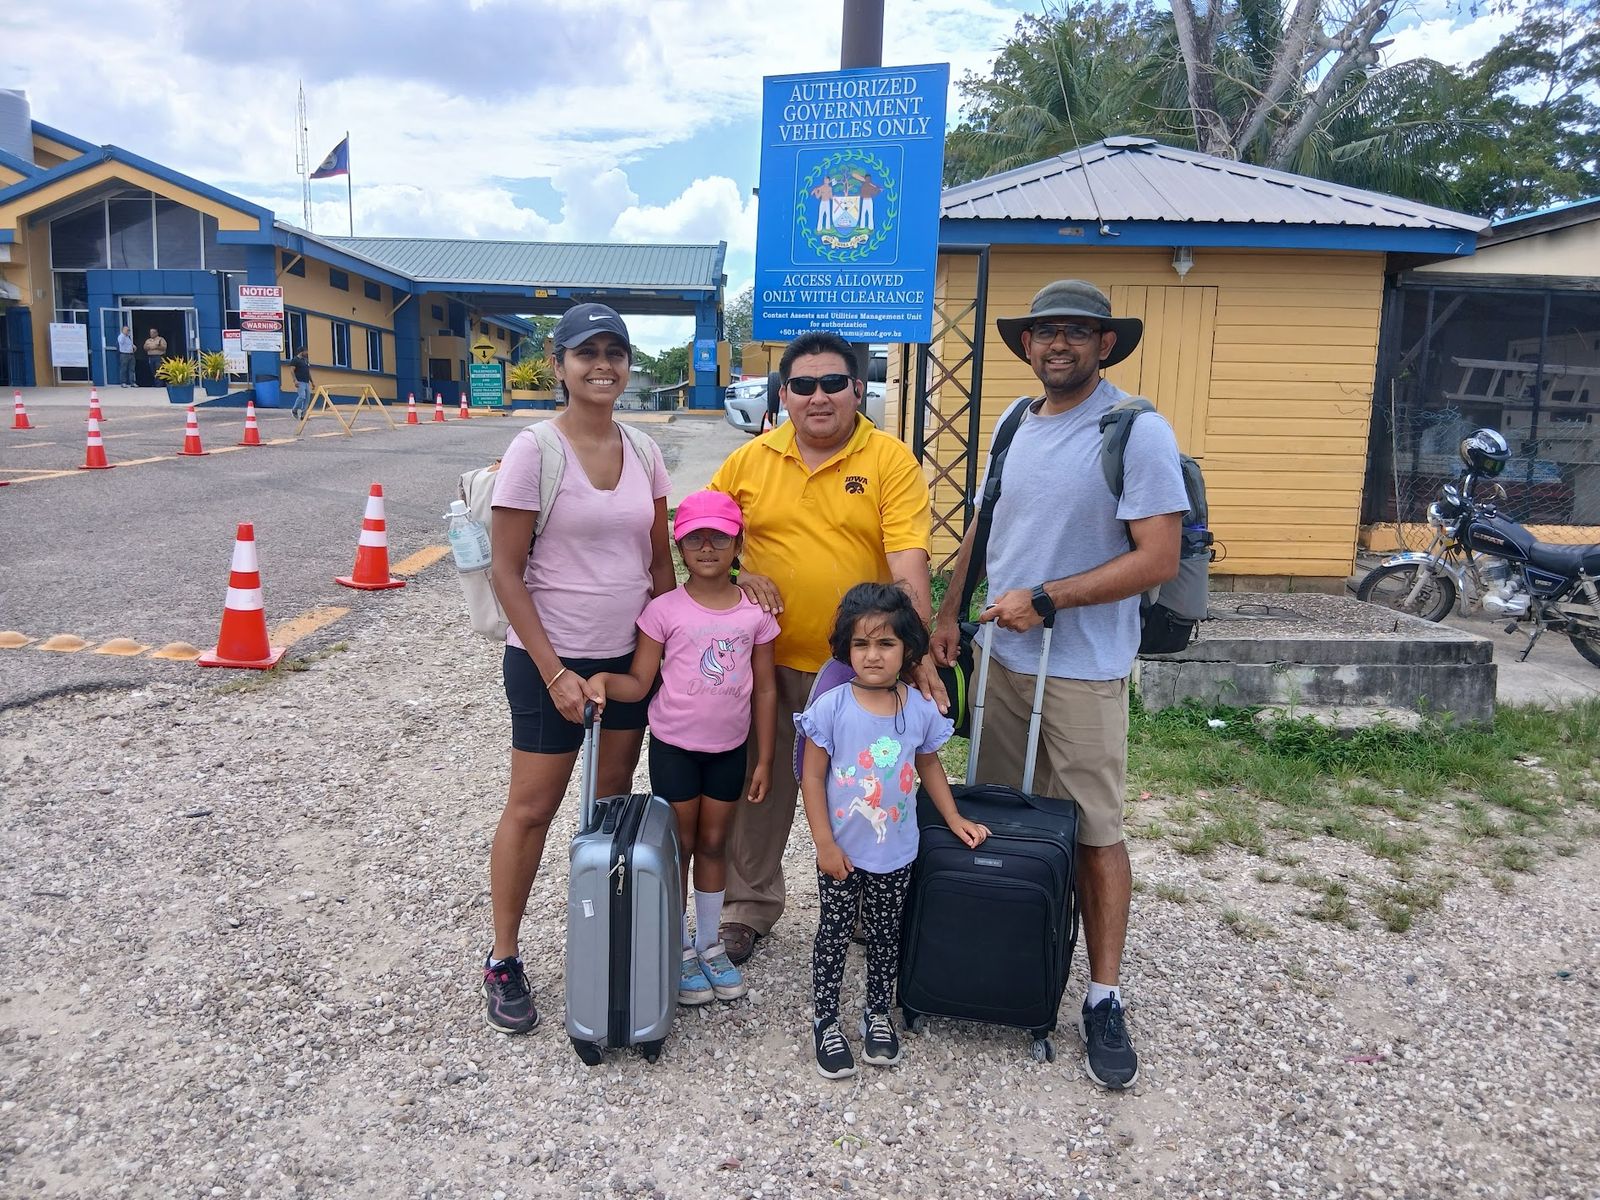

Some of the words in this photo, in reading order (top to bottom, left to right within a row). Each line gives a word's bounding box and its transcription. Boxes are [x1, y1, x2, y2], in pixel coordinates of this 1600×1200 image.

[789, 77, 917, 103] AUTHORIZED
[783, 97, 923, 122] GOVERNMENT
[779, 120, 872, 141] VEHICLES
[877, 116, 932, 137] ONLY
[782, 274, 831, 287] ACCESS
[835, 274, 903, 287] ALLOWED
[242, 287, 280, 297] NOTICE
[762, 290, 797, 303] ONLY
[800, 290, 837, 303] WITH
[840, 291, 924, 304] CLEARANCE
[762, 311, 789, 319] Contact
[860, 312, 904, 321] Management
[246, 322, 278, 330] WARNING
[821, 320, 868, 328] authorization
[844, 475, 868, 485] IOWA
[687, 678, 742, 698] Dreams
